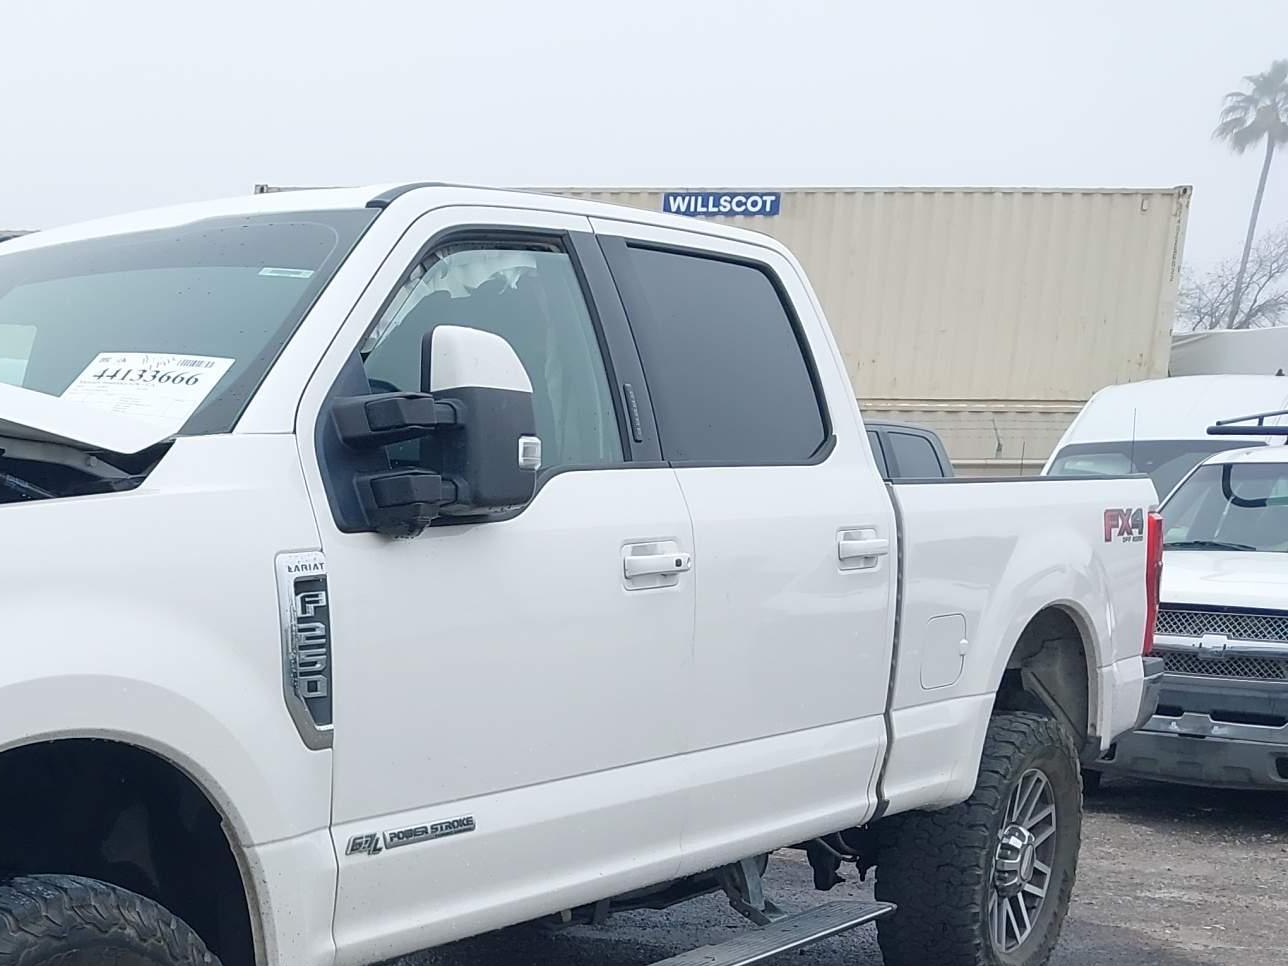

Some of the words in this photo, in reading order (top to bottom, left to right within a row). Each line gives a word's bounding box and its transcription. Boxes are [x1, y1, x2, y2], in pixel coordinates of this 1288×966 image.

[669, 194, 776, 213] WILLSCOT
[92, 367, 203, 386] 44133666
[1103, 508, 1144, 543] FX4
[287, 562, 325, 573] LARIAT
[388, 826, 429, 843] POWER
[430, 816, 474, 834] STROKE
